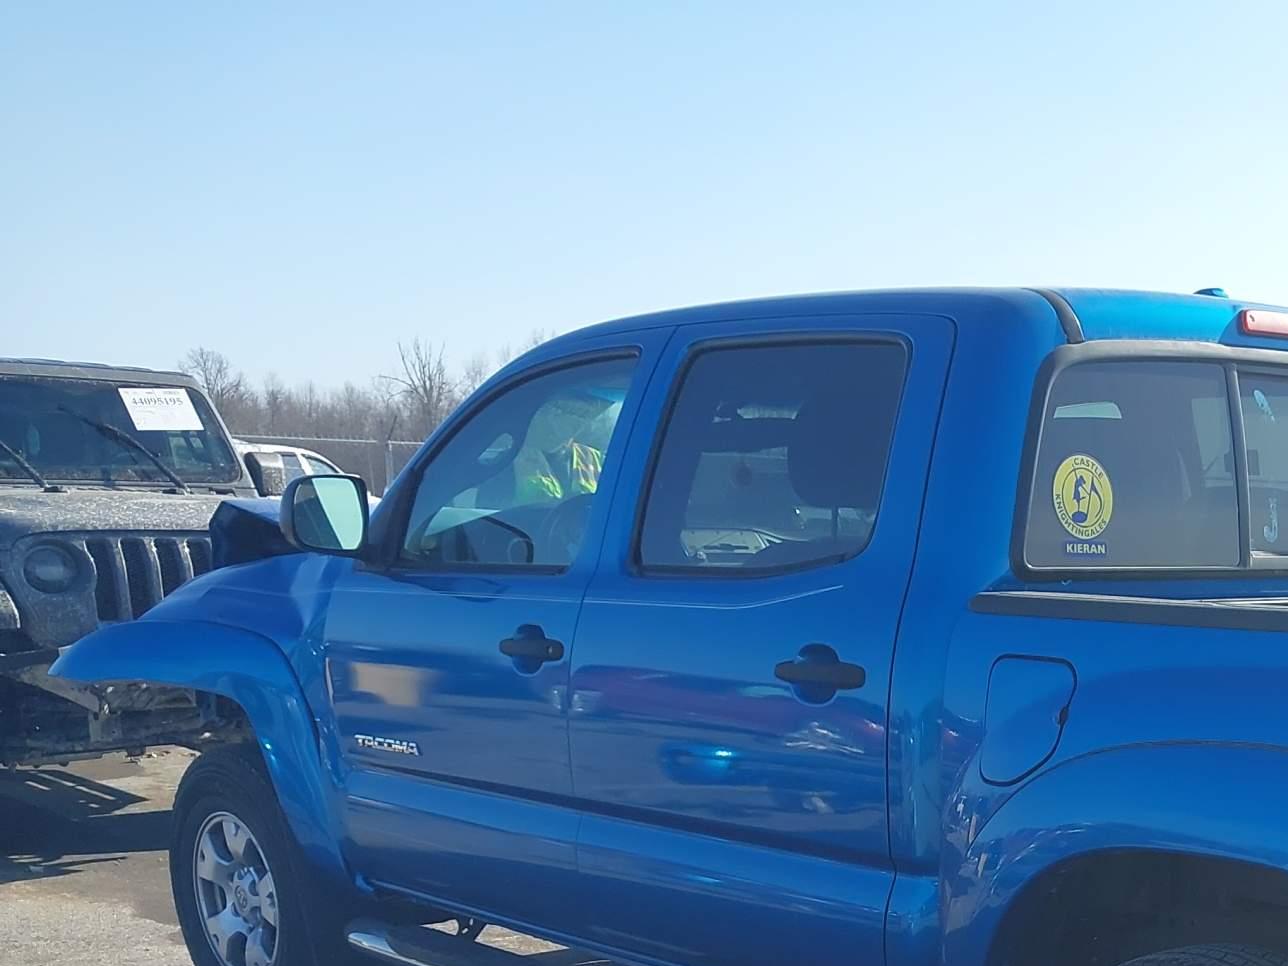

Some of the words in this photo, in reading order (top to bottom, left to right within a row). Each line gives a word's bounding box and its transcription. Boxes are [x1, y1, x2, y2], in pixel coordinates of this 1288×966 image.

[1073, 458, 1103, 479] CASTLE
[1055, 493, 1107, 537] KNIGHTINGALES
[1066, 543, 1106, 554] KIERAN
[354, 734, 420, 756] TACOMA
